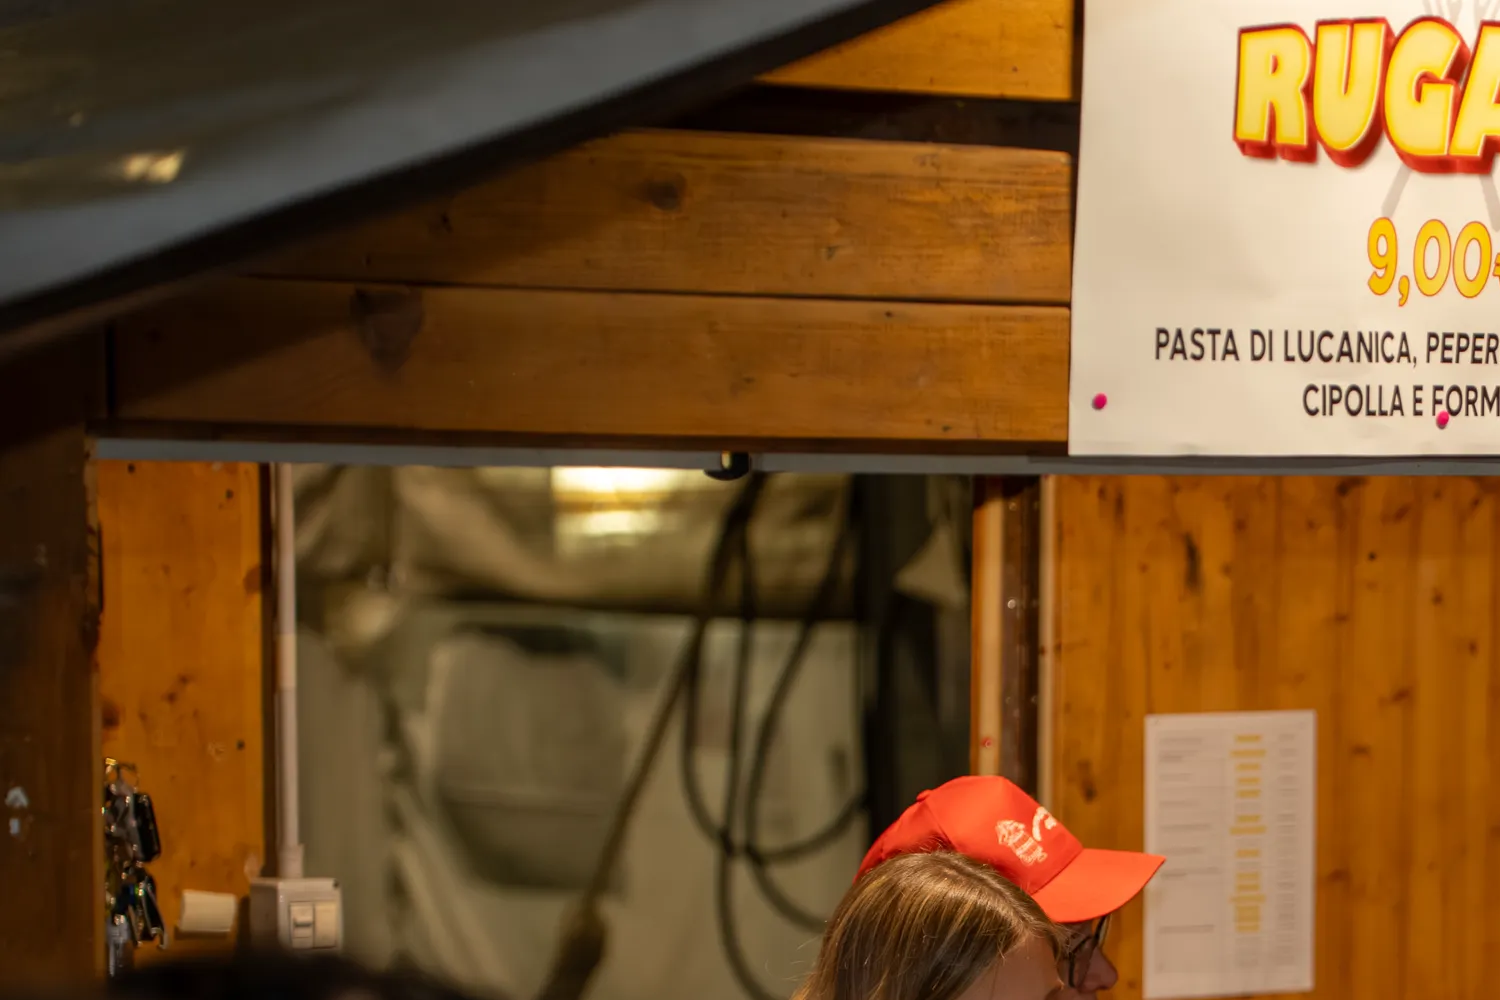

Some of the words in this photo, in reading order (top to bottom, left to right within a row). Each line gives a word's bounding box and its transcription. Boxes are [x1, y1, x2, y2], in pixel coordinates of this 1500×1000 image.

[1155, 327, 1239, 361] PASTA
[1251, 329, 1274, 361] DI
[1284, 330, 1418, 369] LUCANICA,
[1303, 384, 1405, 417] CIPOLLA
[1413, 385, 1423, 417] E
